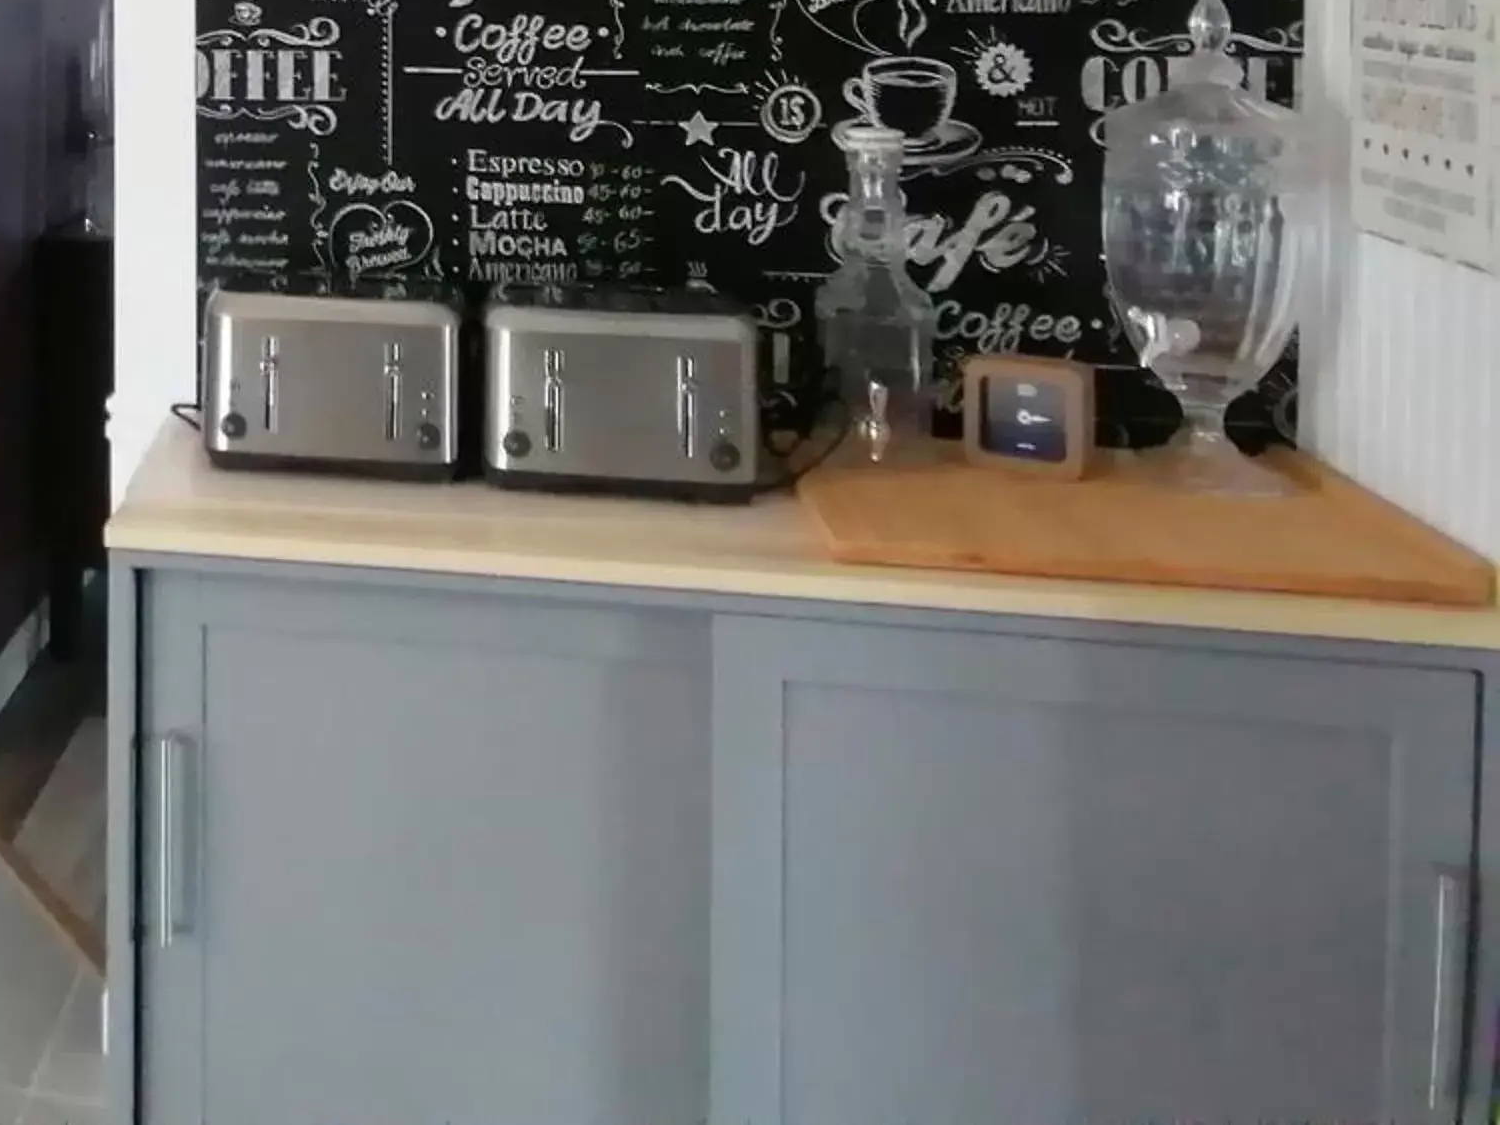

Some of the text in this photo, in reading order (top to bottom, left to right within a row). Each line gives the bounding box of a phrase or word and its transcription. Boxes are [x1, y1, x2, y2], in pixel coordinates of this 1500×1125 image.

[454, 13, 592, 64] Coffee
[463, 56, 587, 88] Served
[435, 88, 601, 141] All Day
[467, 148, 585, 177] Espresso
[701, 148, 804, 202] All
[466, 176, 585, 206] Cappuccino
[660, 176, 797, 245] day
[470, 204, 548, 231] Latte
[469, 228, 568, 259] MOCHA
[935, 299, 1083, 354] Coffee
